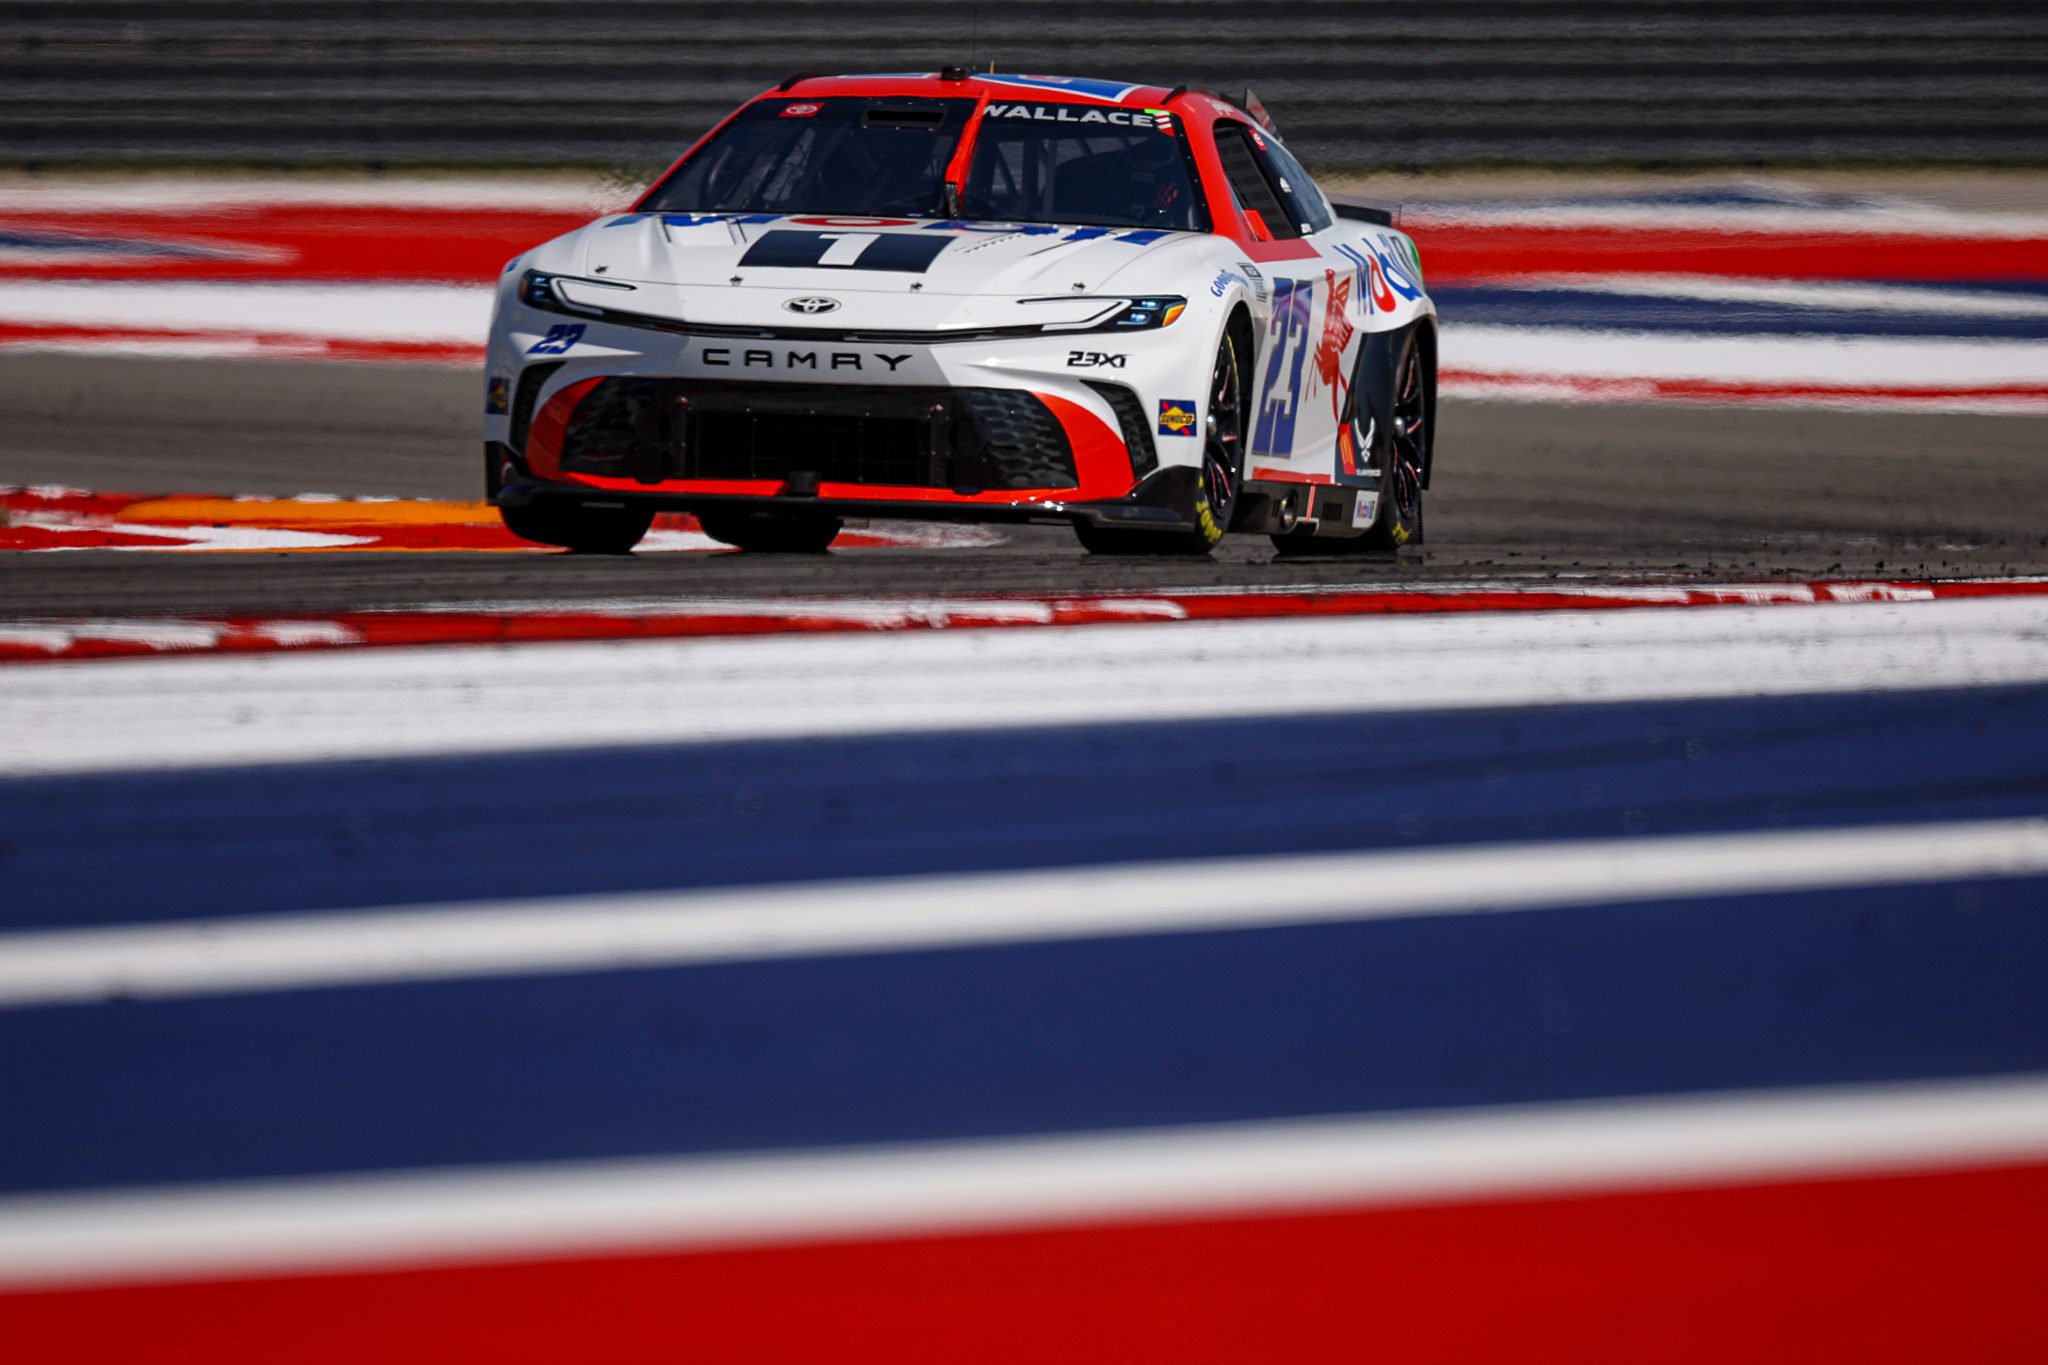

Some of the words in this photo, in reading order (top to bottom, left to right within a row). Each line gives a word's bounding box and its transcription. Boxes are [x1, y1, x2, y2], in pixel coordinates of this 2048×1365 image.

[983, 104, 1153, 127] WALLACE
[526, 324, 587, 354] 23
[702, 349, 913, 371] CAMRY
[1252, 277, 1313, 459] 23
[1160, 414, 1193, 424] SUNOCO
